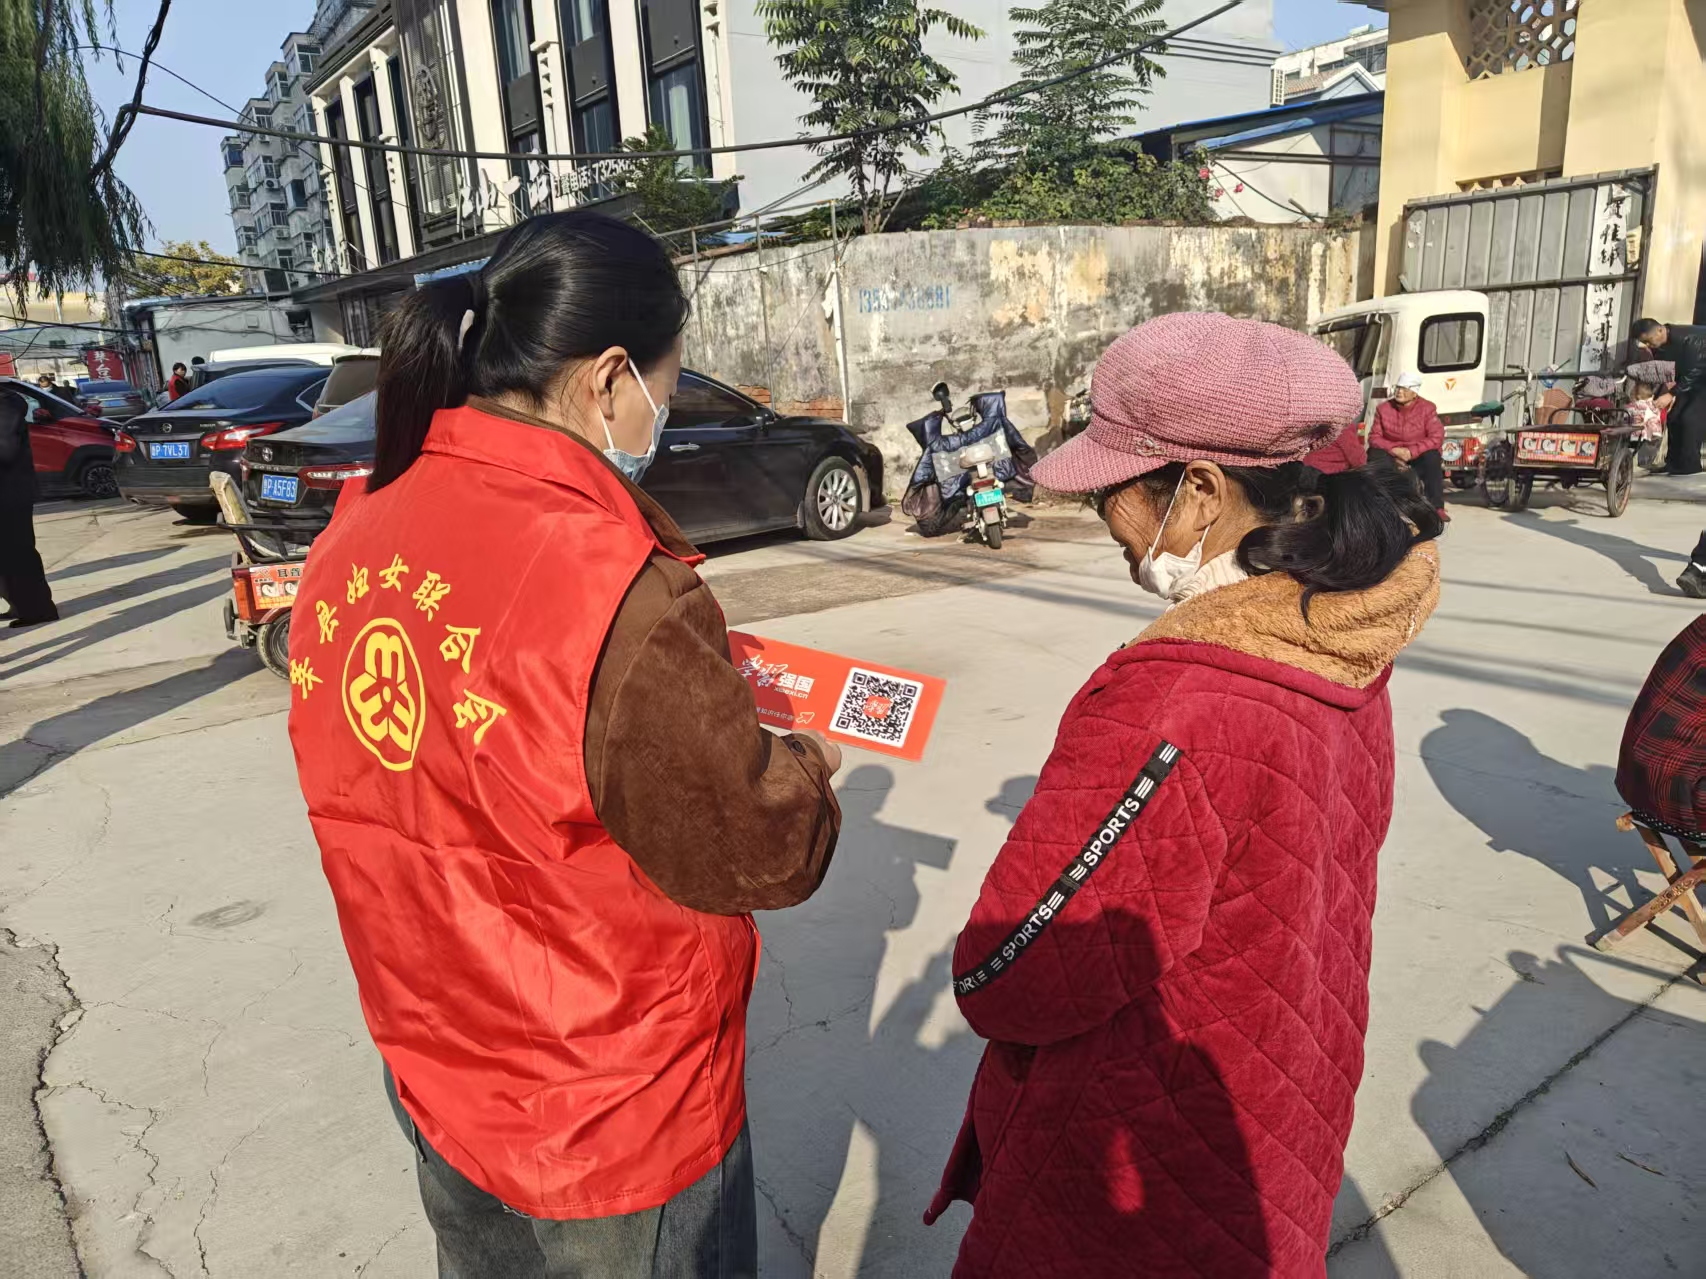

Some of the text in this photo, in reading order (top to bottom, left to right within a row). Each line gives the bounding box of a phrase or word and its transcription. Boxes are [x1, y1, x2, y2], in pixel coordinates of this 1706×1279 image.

[290, 554, 507, 745] 莘县妇女联合会
[736, 654, 815, 693] 学习强国
[1084, 797, 1140, 867] SPORTS
